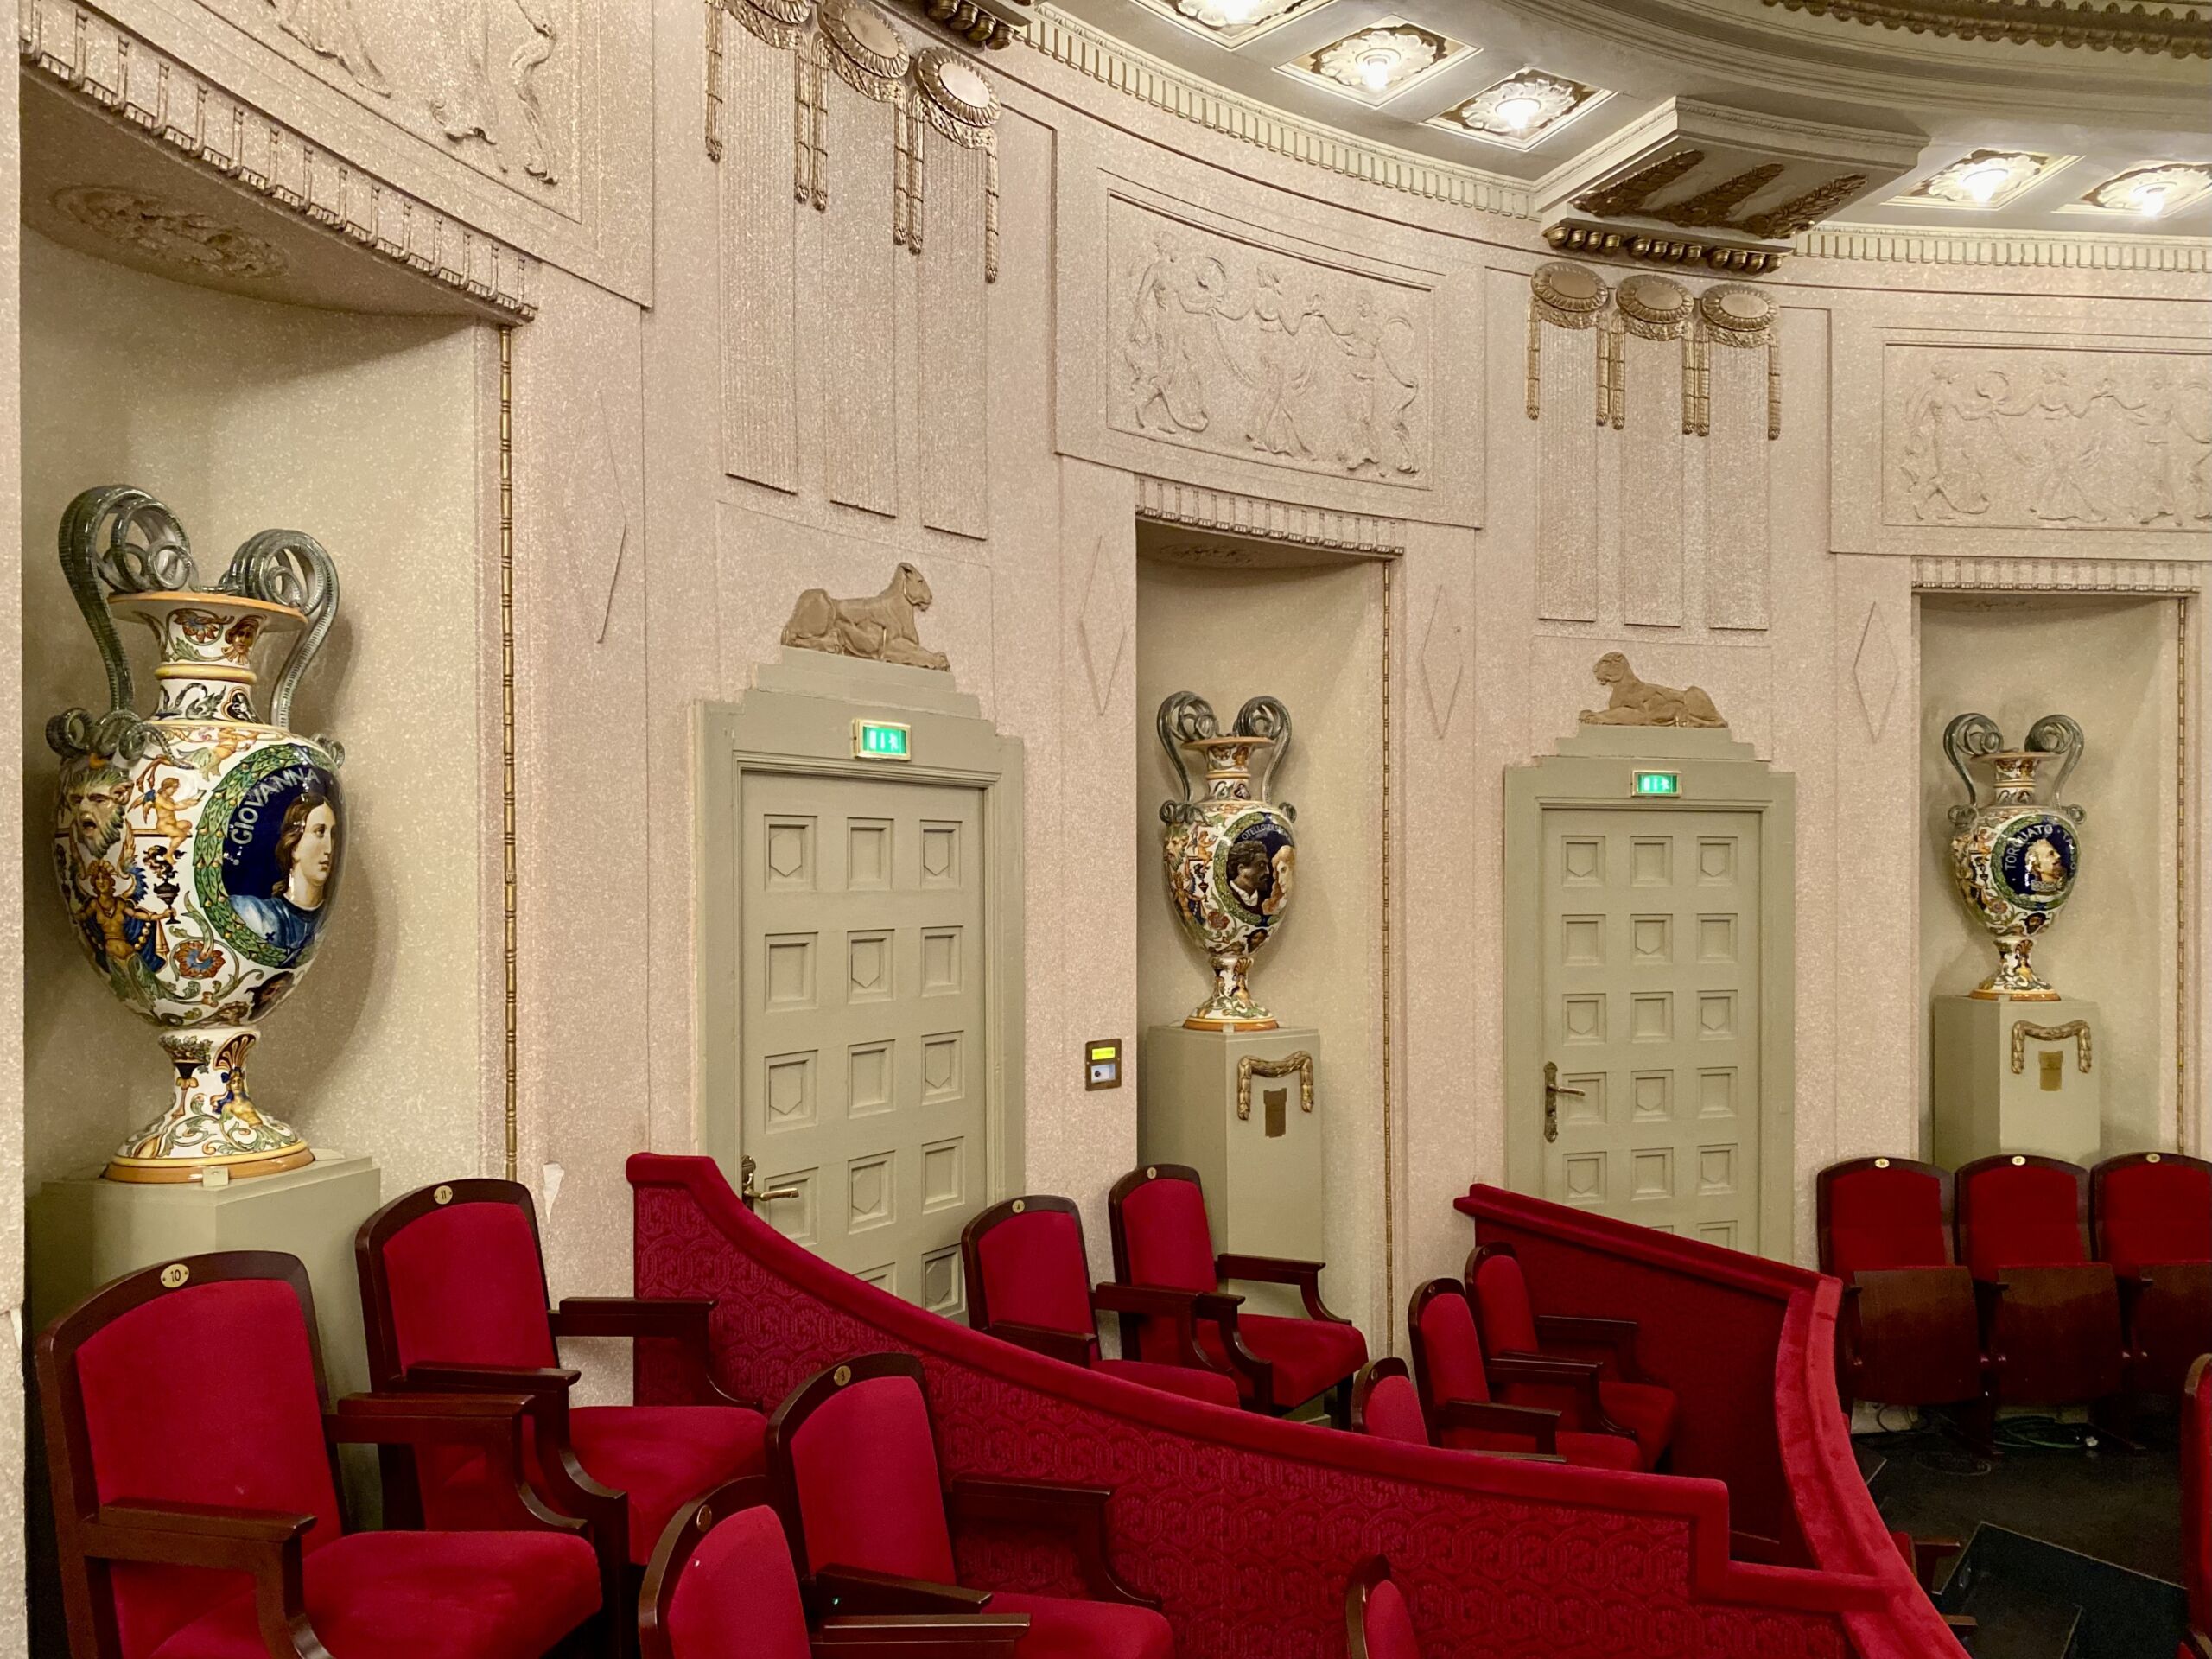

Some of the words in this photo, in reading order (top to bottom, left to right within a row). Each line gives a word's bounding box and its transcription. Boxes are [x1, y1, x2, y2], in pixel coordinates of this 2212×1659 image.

[230, 767, 321, 845] GIOVANNA
[1241, 823, 1266, 840] OTELLO
[2005, 824, 2053, 871] TORQUATO
[441, 1190, 447, 1200] 11
[170, 1269, 181, 1282] 10
